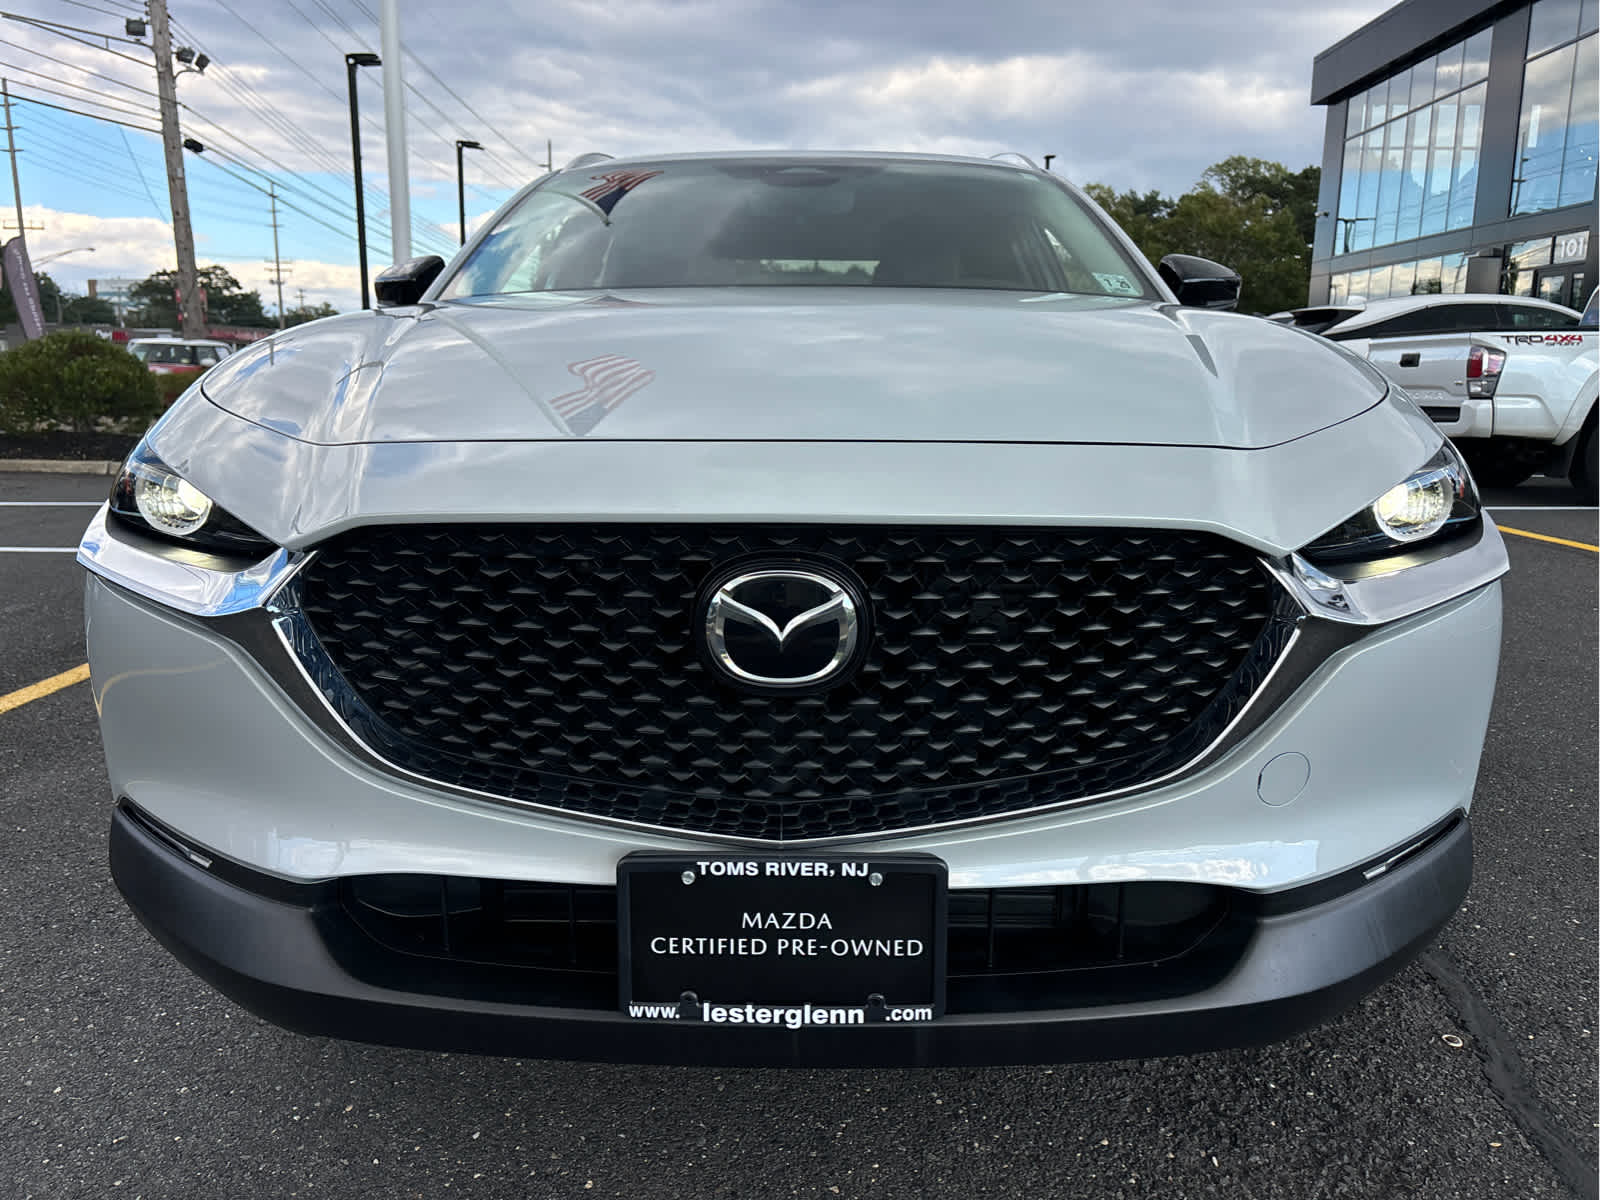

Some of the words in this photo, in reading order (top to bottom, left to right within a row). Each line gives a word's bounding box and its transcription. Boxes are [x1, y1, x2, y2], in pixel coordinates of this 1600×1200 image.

[1560, 237, 1585, 258] 101
[1501, 335, 1544, 345] TRD
[697, 861, 759, 877] TOMS
[765, 862, 835, 877] RIVER,
[841, 863, 869, 877] NJ
[741, 912, 833, 930] MAZDA
[650, 937, 768, 956] CERTIFIED
[777, 938, 924, 957] PRE-OWNED
[629, 1004, 681, 1020] www.
[703, 1003, 865, 1030] lesterglenn
[885, 1007, 933, 1022] .com
